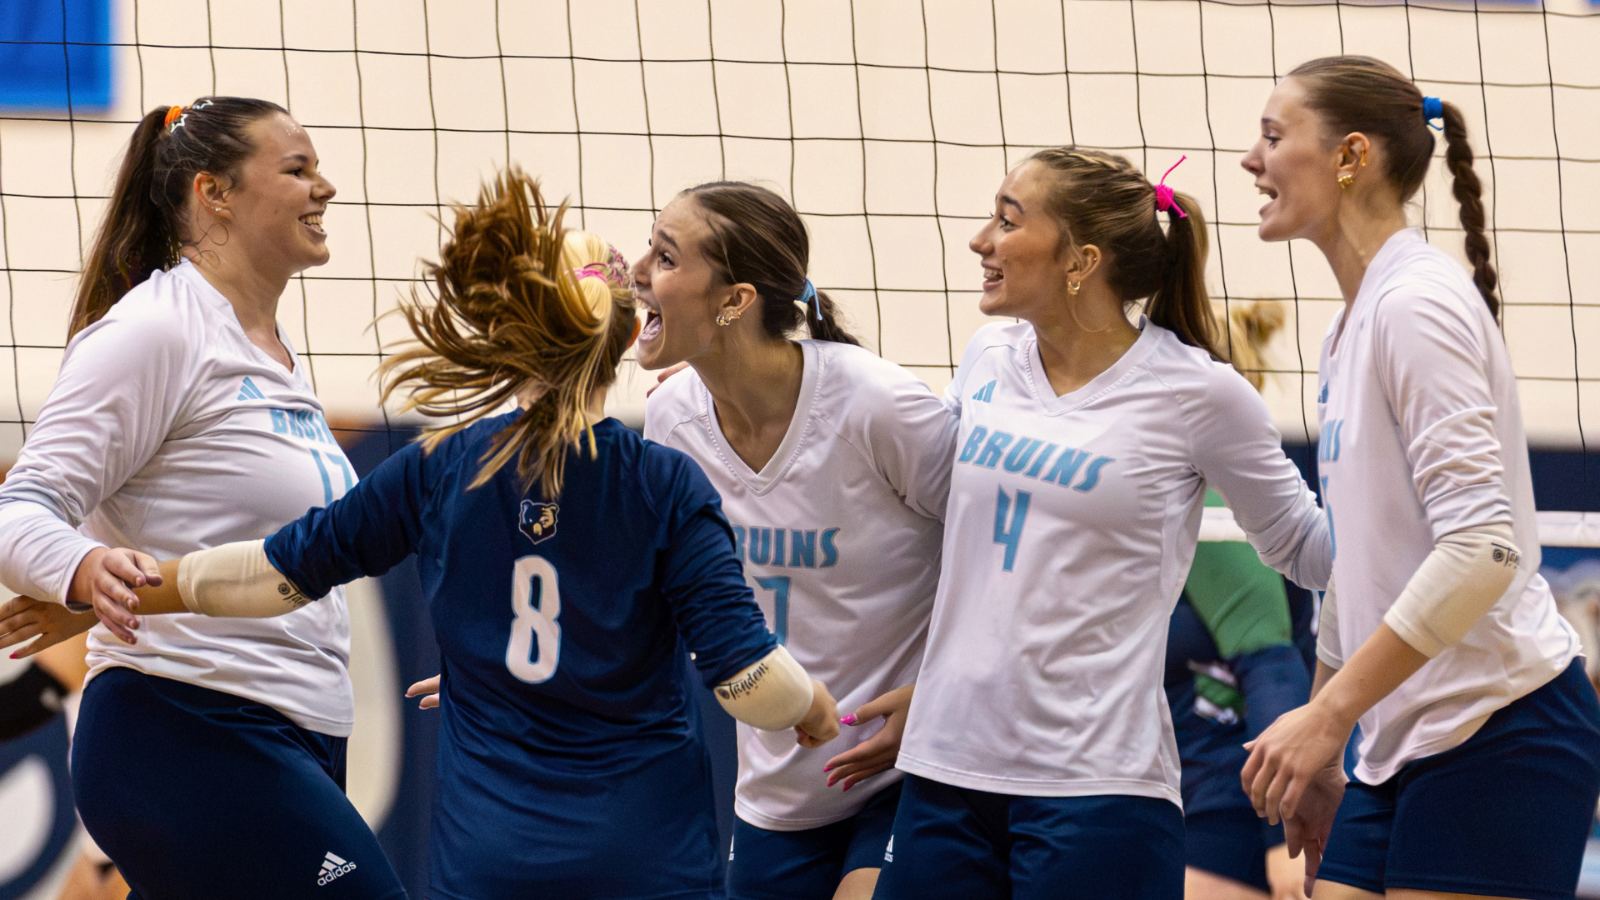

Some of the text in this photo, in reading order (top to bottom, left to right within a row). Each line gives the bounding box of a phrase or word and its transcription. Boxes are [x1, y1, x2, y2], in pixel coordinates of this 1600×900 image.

[308, 447, 354, 508] 17
[957, 425, 1116, 494] BRUINS
[731, 525, 841, 568] RUINS
[992, 484, 1032, 573] 4
[505, 554, 561, 685] 8
[752, 575, 791, 648] 7
[317, 861, 357, 886] adidas
